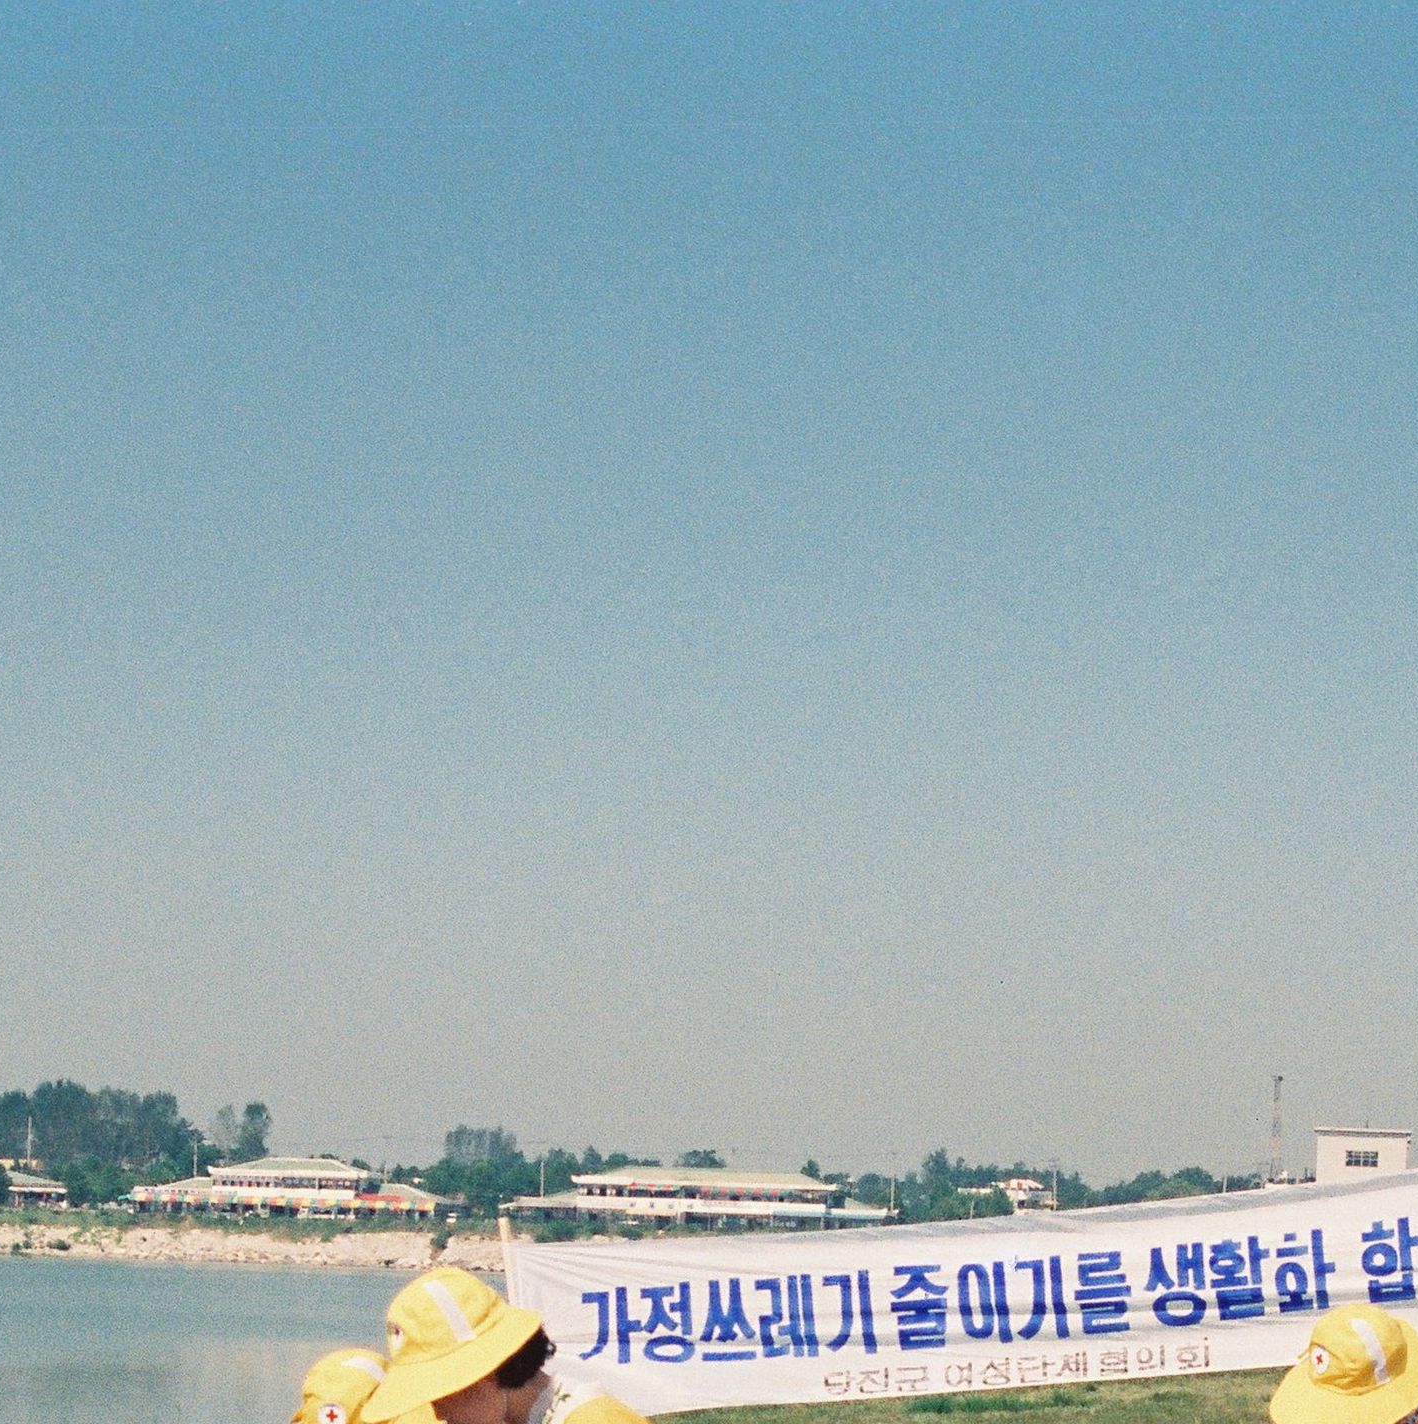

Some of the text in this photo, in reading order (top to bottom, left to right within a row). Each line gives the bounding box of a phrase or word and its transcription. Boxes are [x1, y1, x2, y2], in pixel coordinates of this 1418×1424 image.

[580, 1270, 876, 1363] 가정쓰레기
[890, 1251, 1131, 1350] 줄이기를
[1145, 1228, 1336, 1327] 생활화
[823, 1366, 930, 1395] 당진군
